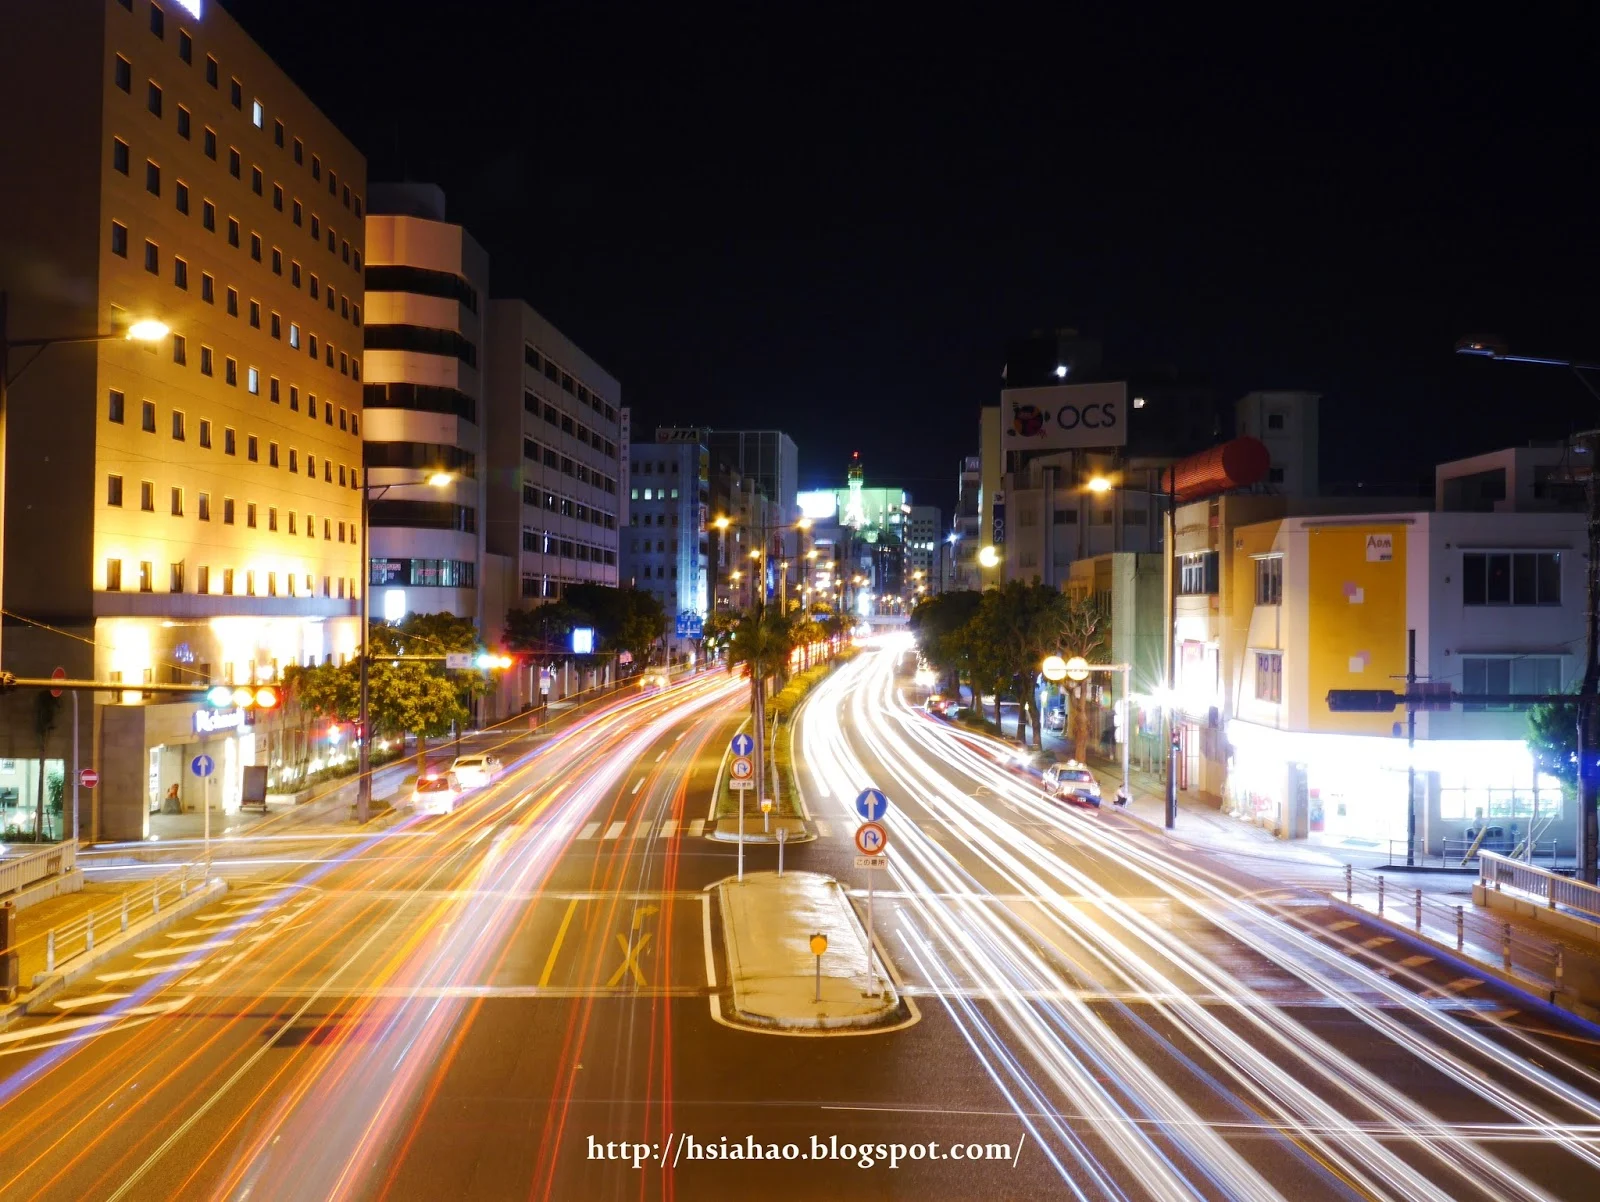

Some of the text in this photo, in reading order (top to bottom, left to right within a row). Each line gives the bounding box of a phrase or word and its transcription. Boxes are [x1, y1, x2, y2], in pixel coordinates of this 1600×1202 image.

[1057, 403, 1117, 430] OCS
[671, 430, 697, 439] JTA
[994, 518, 1004, 543] OCS
[856, 859, 885, 867] この場所
